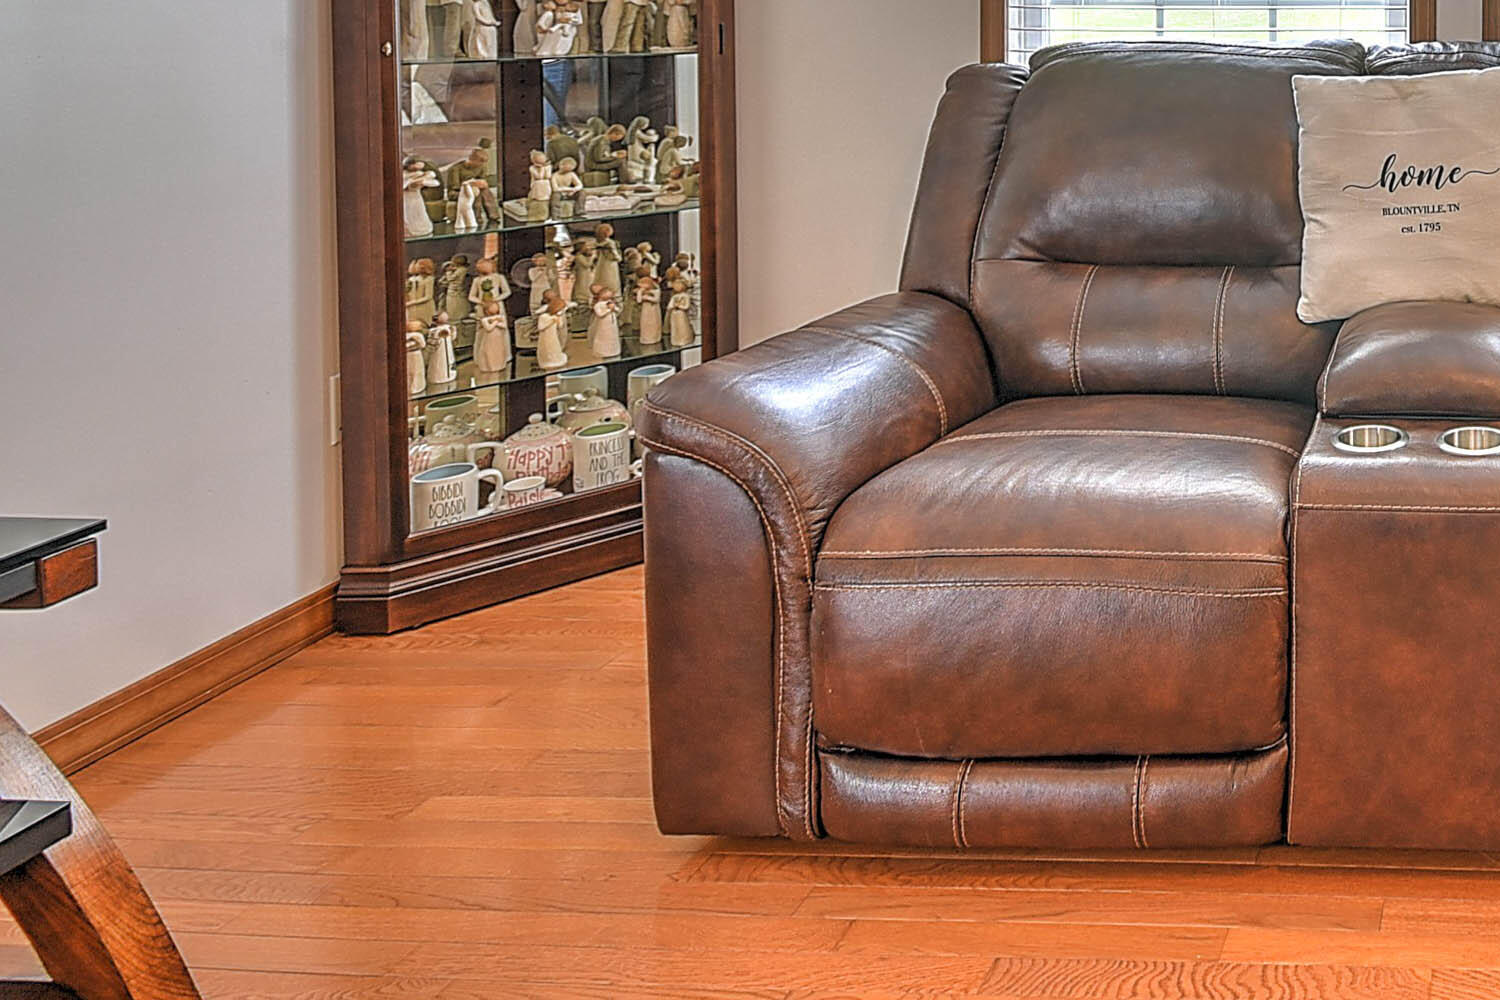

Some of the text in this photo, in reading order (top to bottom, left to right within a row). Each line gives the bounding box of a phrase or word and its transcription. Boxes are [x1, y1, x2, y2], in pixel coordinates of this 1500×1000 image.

[1447, 203, 1460, 213] TN
[1419, 222, 1441, 233] 1795
[507, 446, 553, 470] Happy
[588, 456, 609, 473] AND
